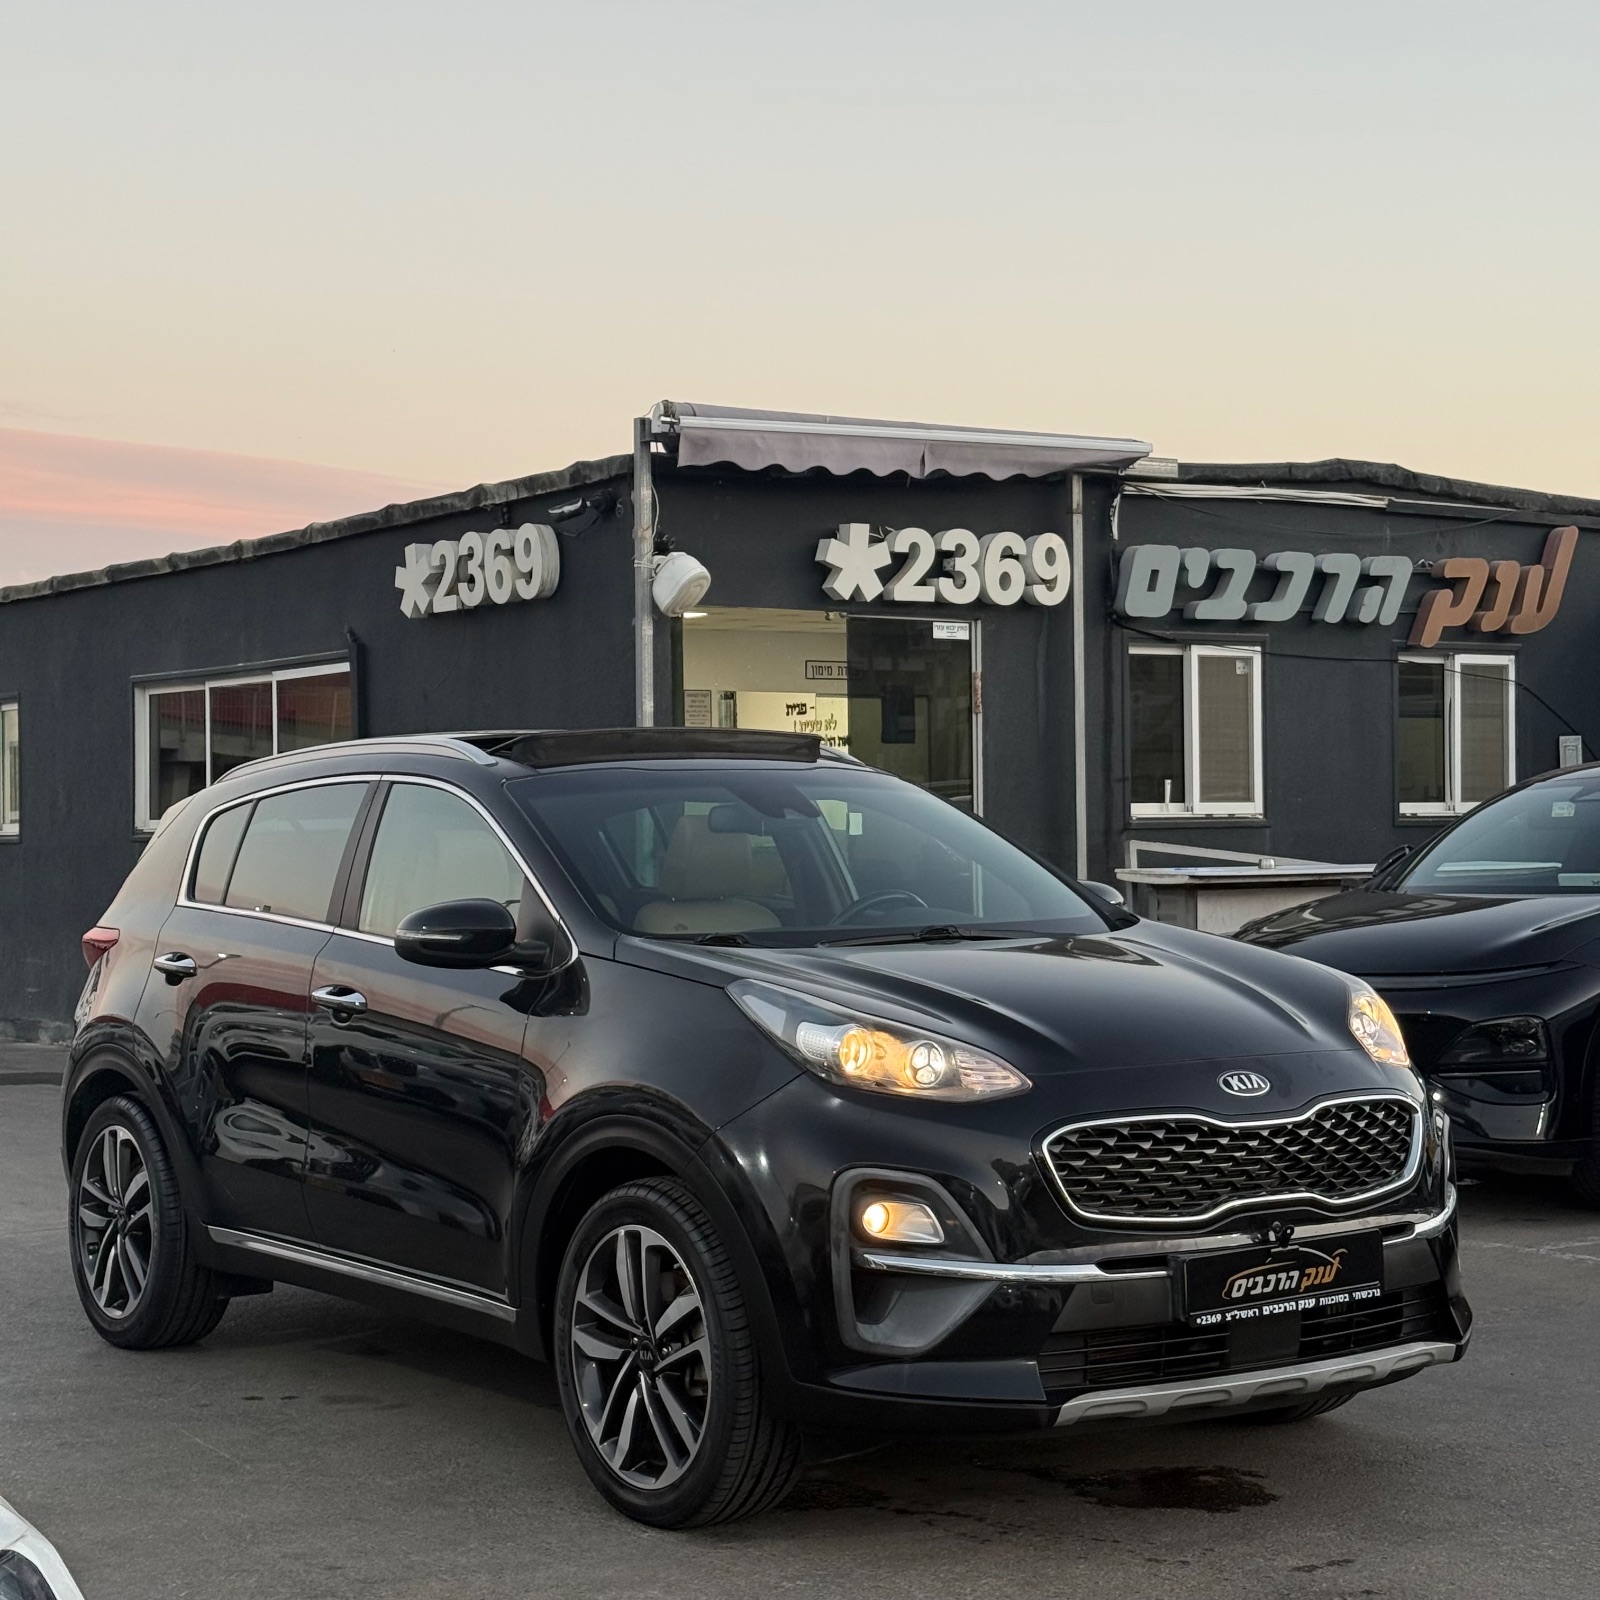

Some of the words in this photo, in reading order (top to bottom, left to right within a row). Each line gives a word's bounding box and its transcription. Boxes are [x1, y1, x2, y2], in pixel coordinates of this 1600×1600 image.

[1114, 544, 1413, 626] הרכבים
[1408, 525, 1579, 648] ענק
[810, 665, 833, 678] מימון
[1225, 1074, 1266, 1091] KIA
[1299, 1256, 1340, 1292] ענק
[1231, 1270, 1300, 1298] הרכבים
[1319, 1294, 1350, 1307] בסוכנות
[1352, 1288, 1381, 1301] נרכשתי
[1262, 1301, 1297, 1316] הרכבים
[1298, 1298, 1317, 1311] ענק
